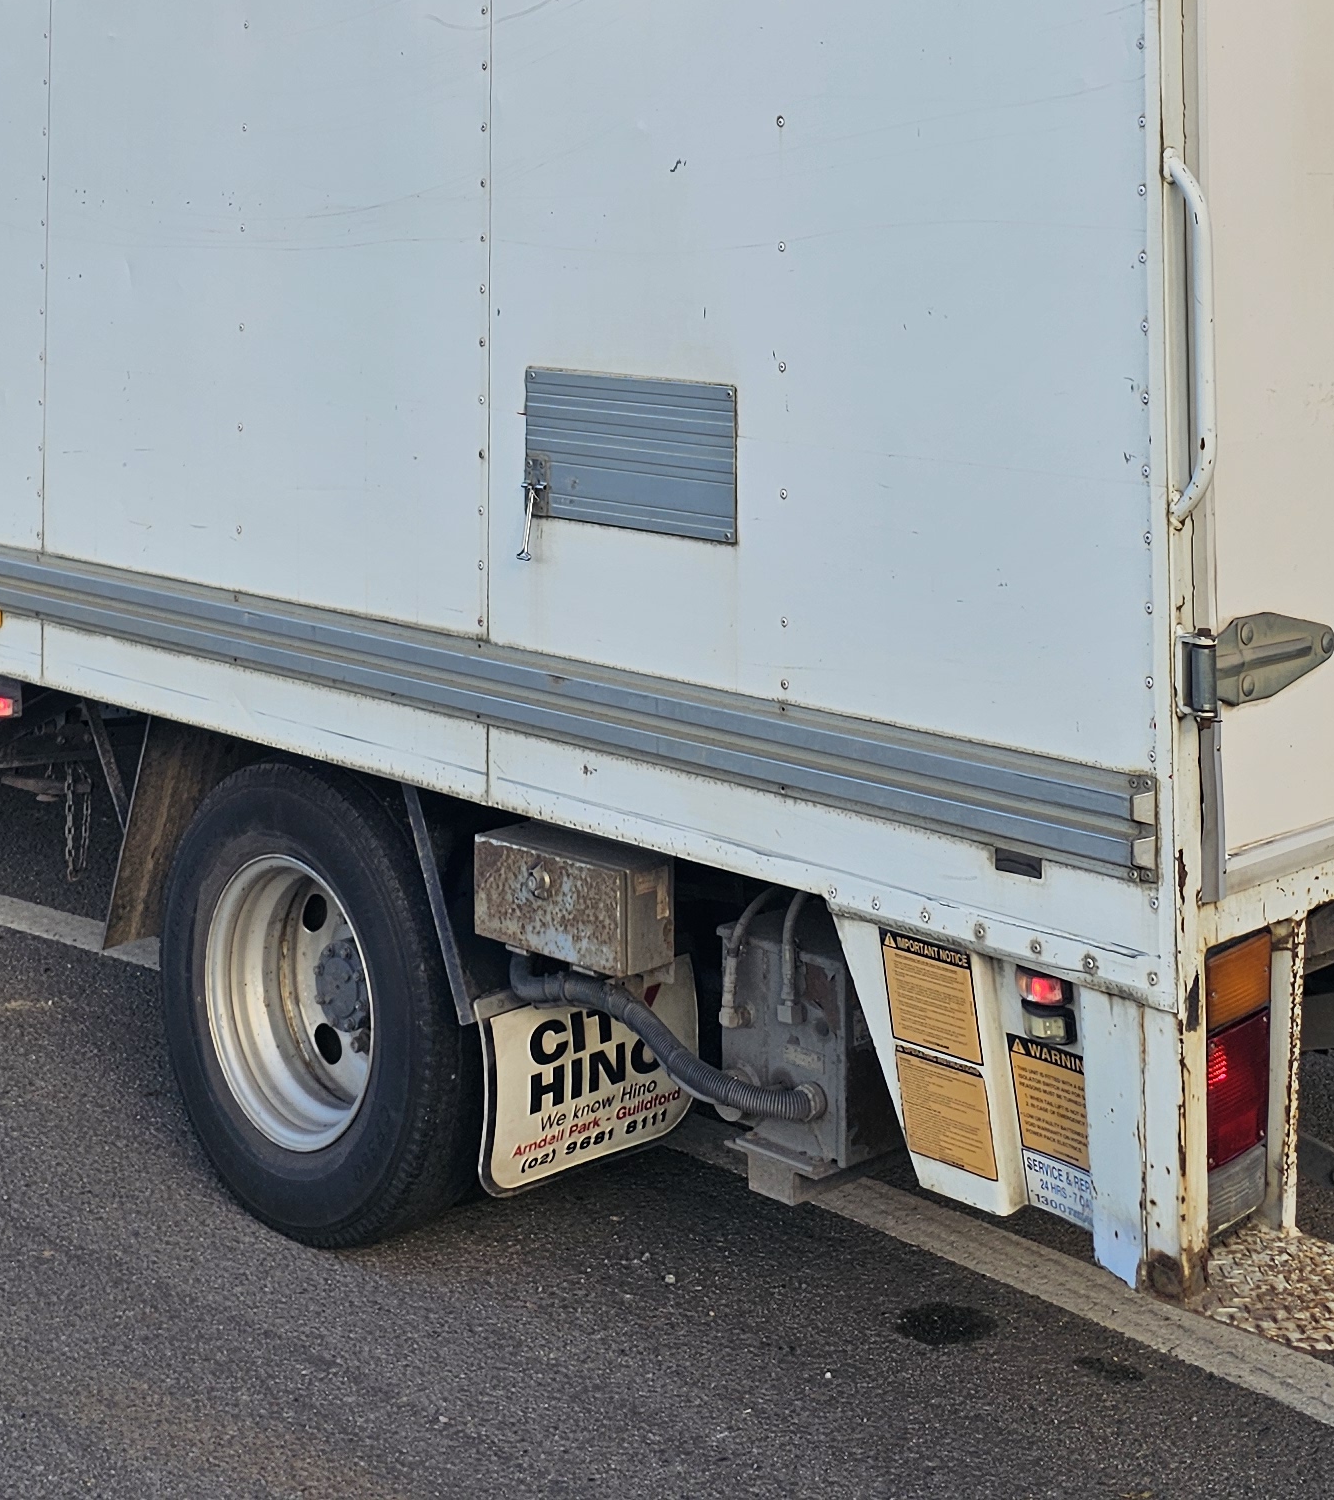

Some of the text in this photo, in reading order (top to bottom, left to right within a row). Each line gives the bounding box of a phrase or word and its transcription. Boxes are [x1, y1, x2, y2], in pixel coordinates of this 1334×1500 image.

[896, 937, 968, 966] IMPORTANT NOTICE
[530, 1009, 612, 1065] CIT
[1028, 1043, 1084, 1071] WARNIN
[541, 1080, 657, 1132] We know Hino
[512, 1129, 565, 1158] Arndell
[569, 1116, 601, 1137] Park
[616, 1087, 681, 1121] Guildford
[521, 1108, 667, 1173] (02) 9681 8111
[1027, 1156, 1063, 1182] SERVICE
[1040, 1179, 1049, 1191] 24
[1035, 1193, 1066, 1213] 1300
